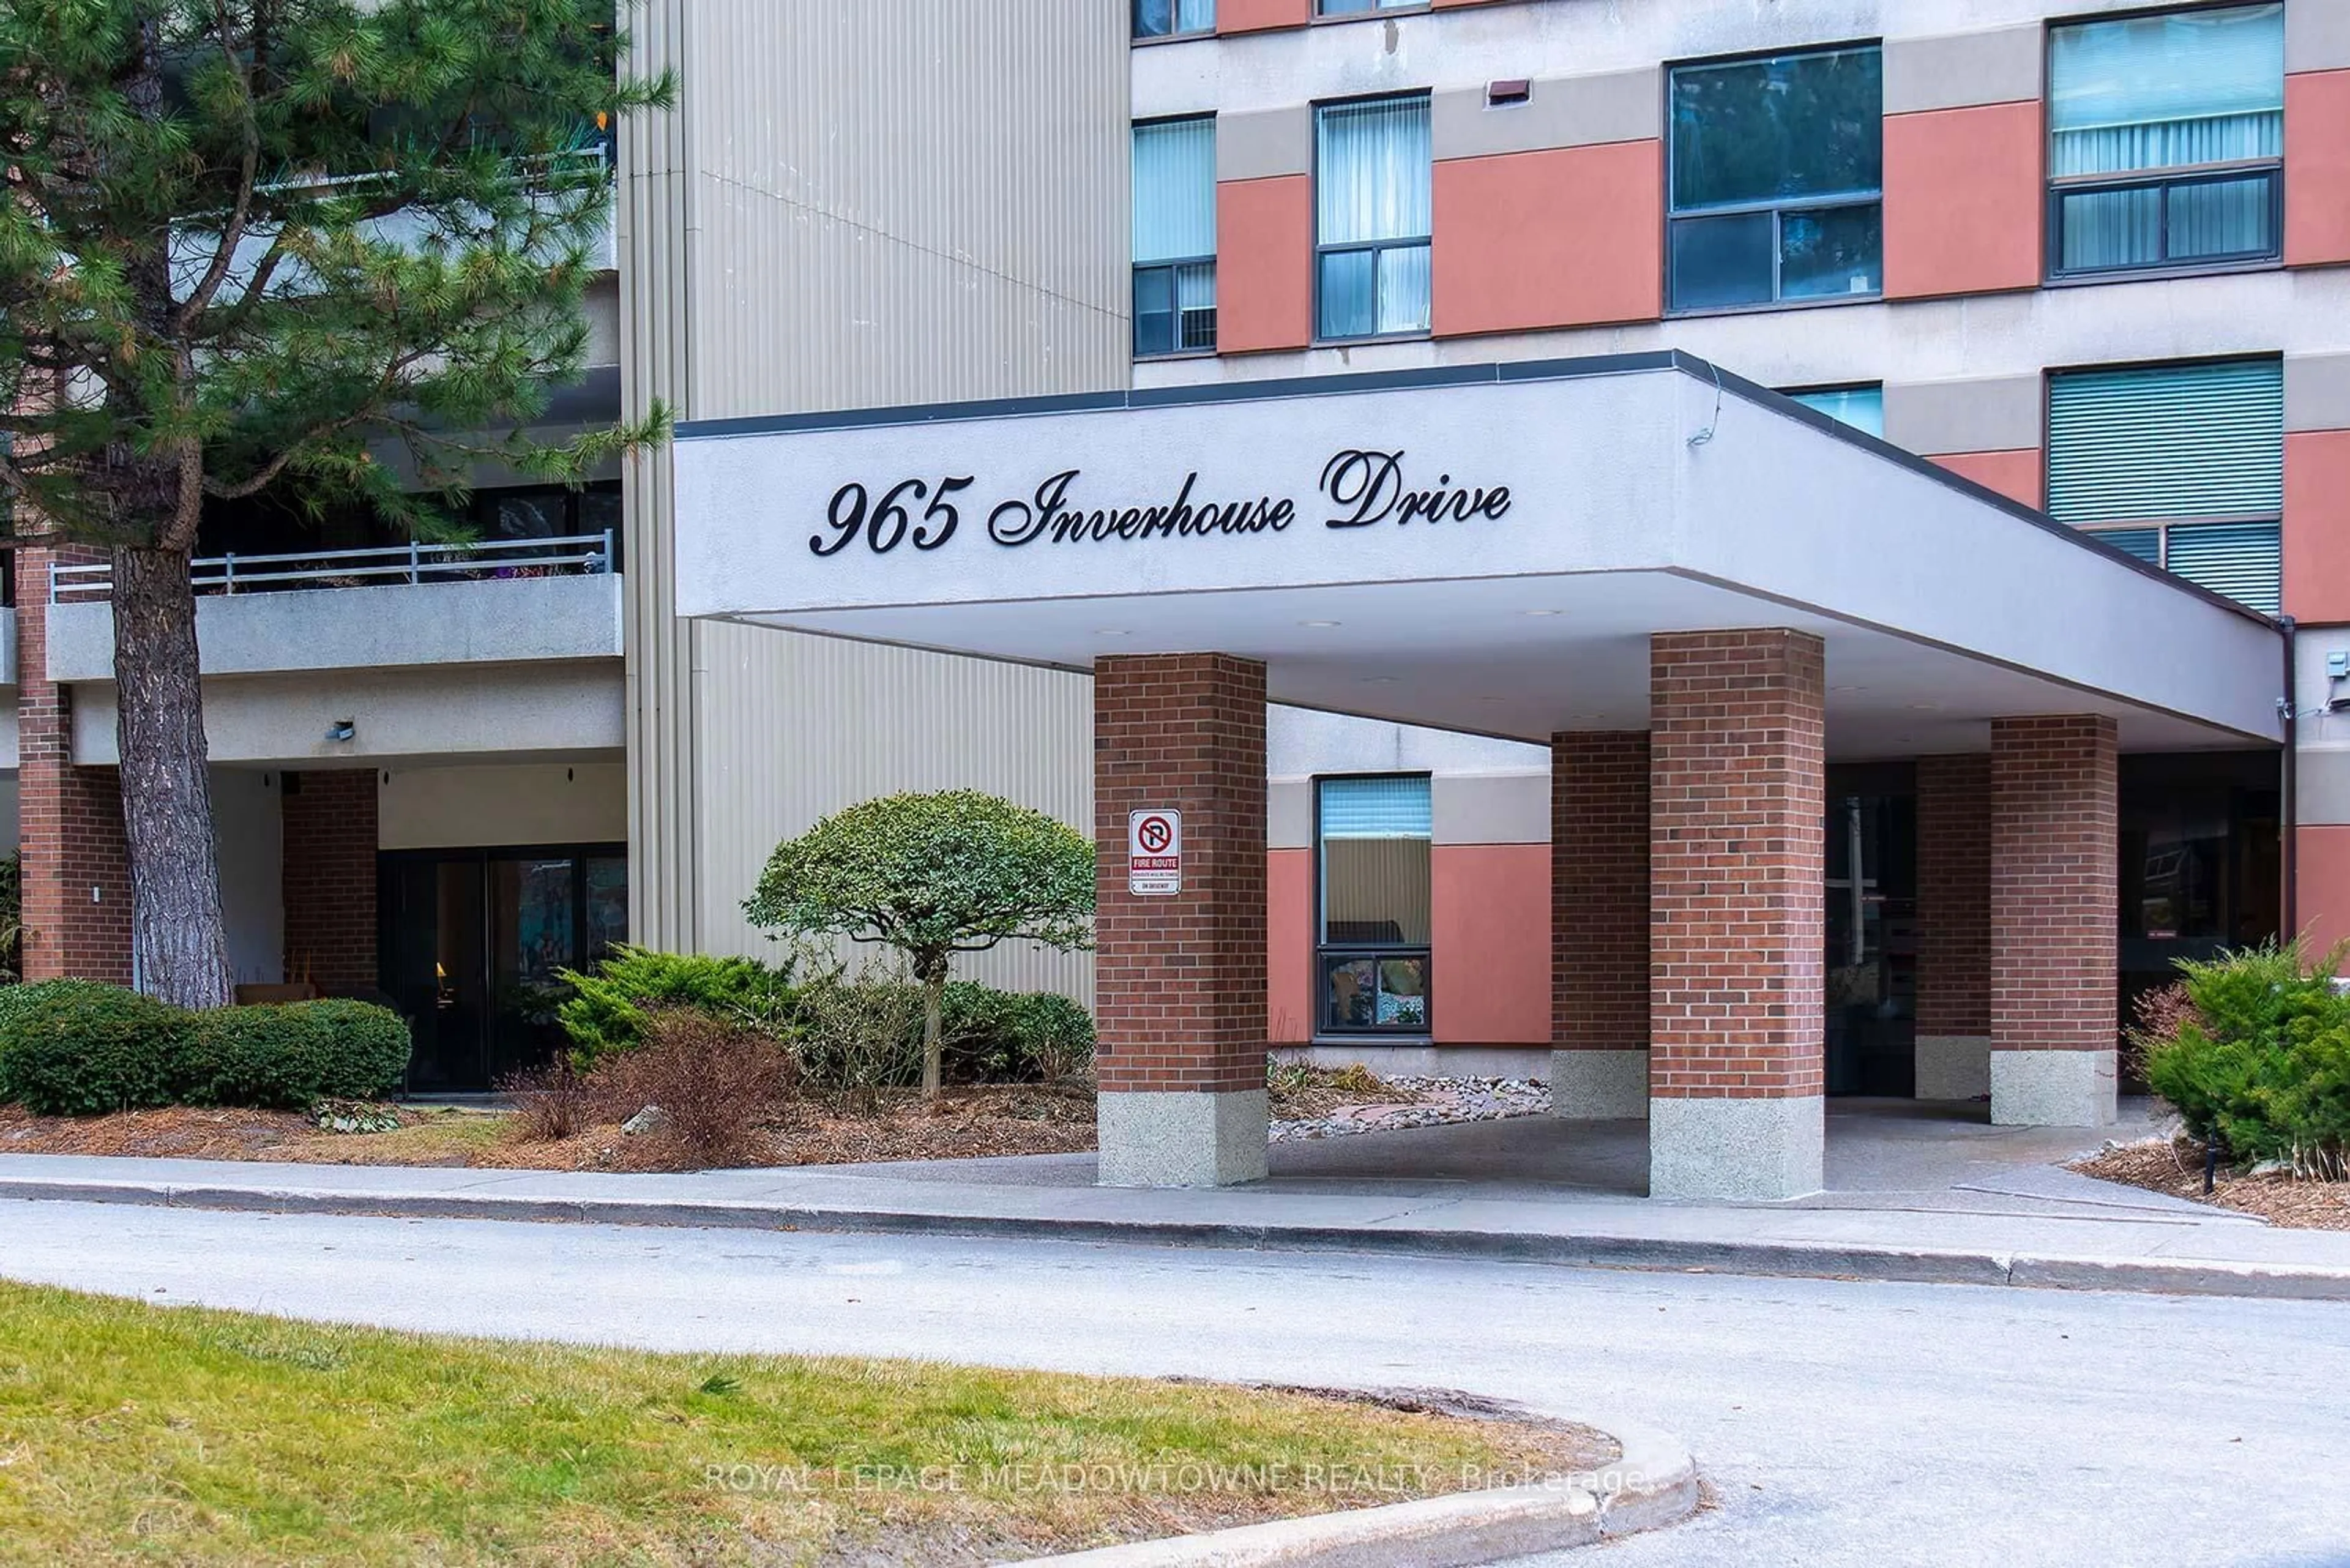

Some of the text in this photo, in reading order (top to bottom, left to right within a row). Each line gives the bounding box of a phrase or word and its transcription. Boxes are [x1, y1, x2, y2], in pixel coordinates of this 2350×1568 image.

[809, 449, 1512, 558] 965 Inverhouse Drive
[1133, 858, 1177, 868] FIRE ROUTE
